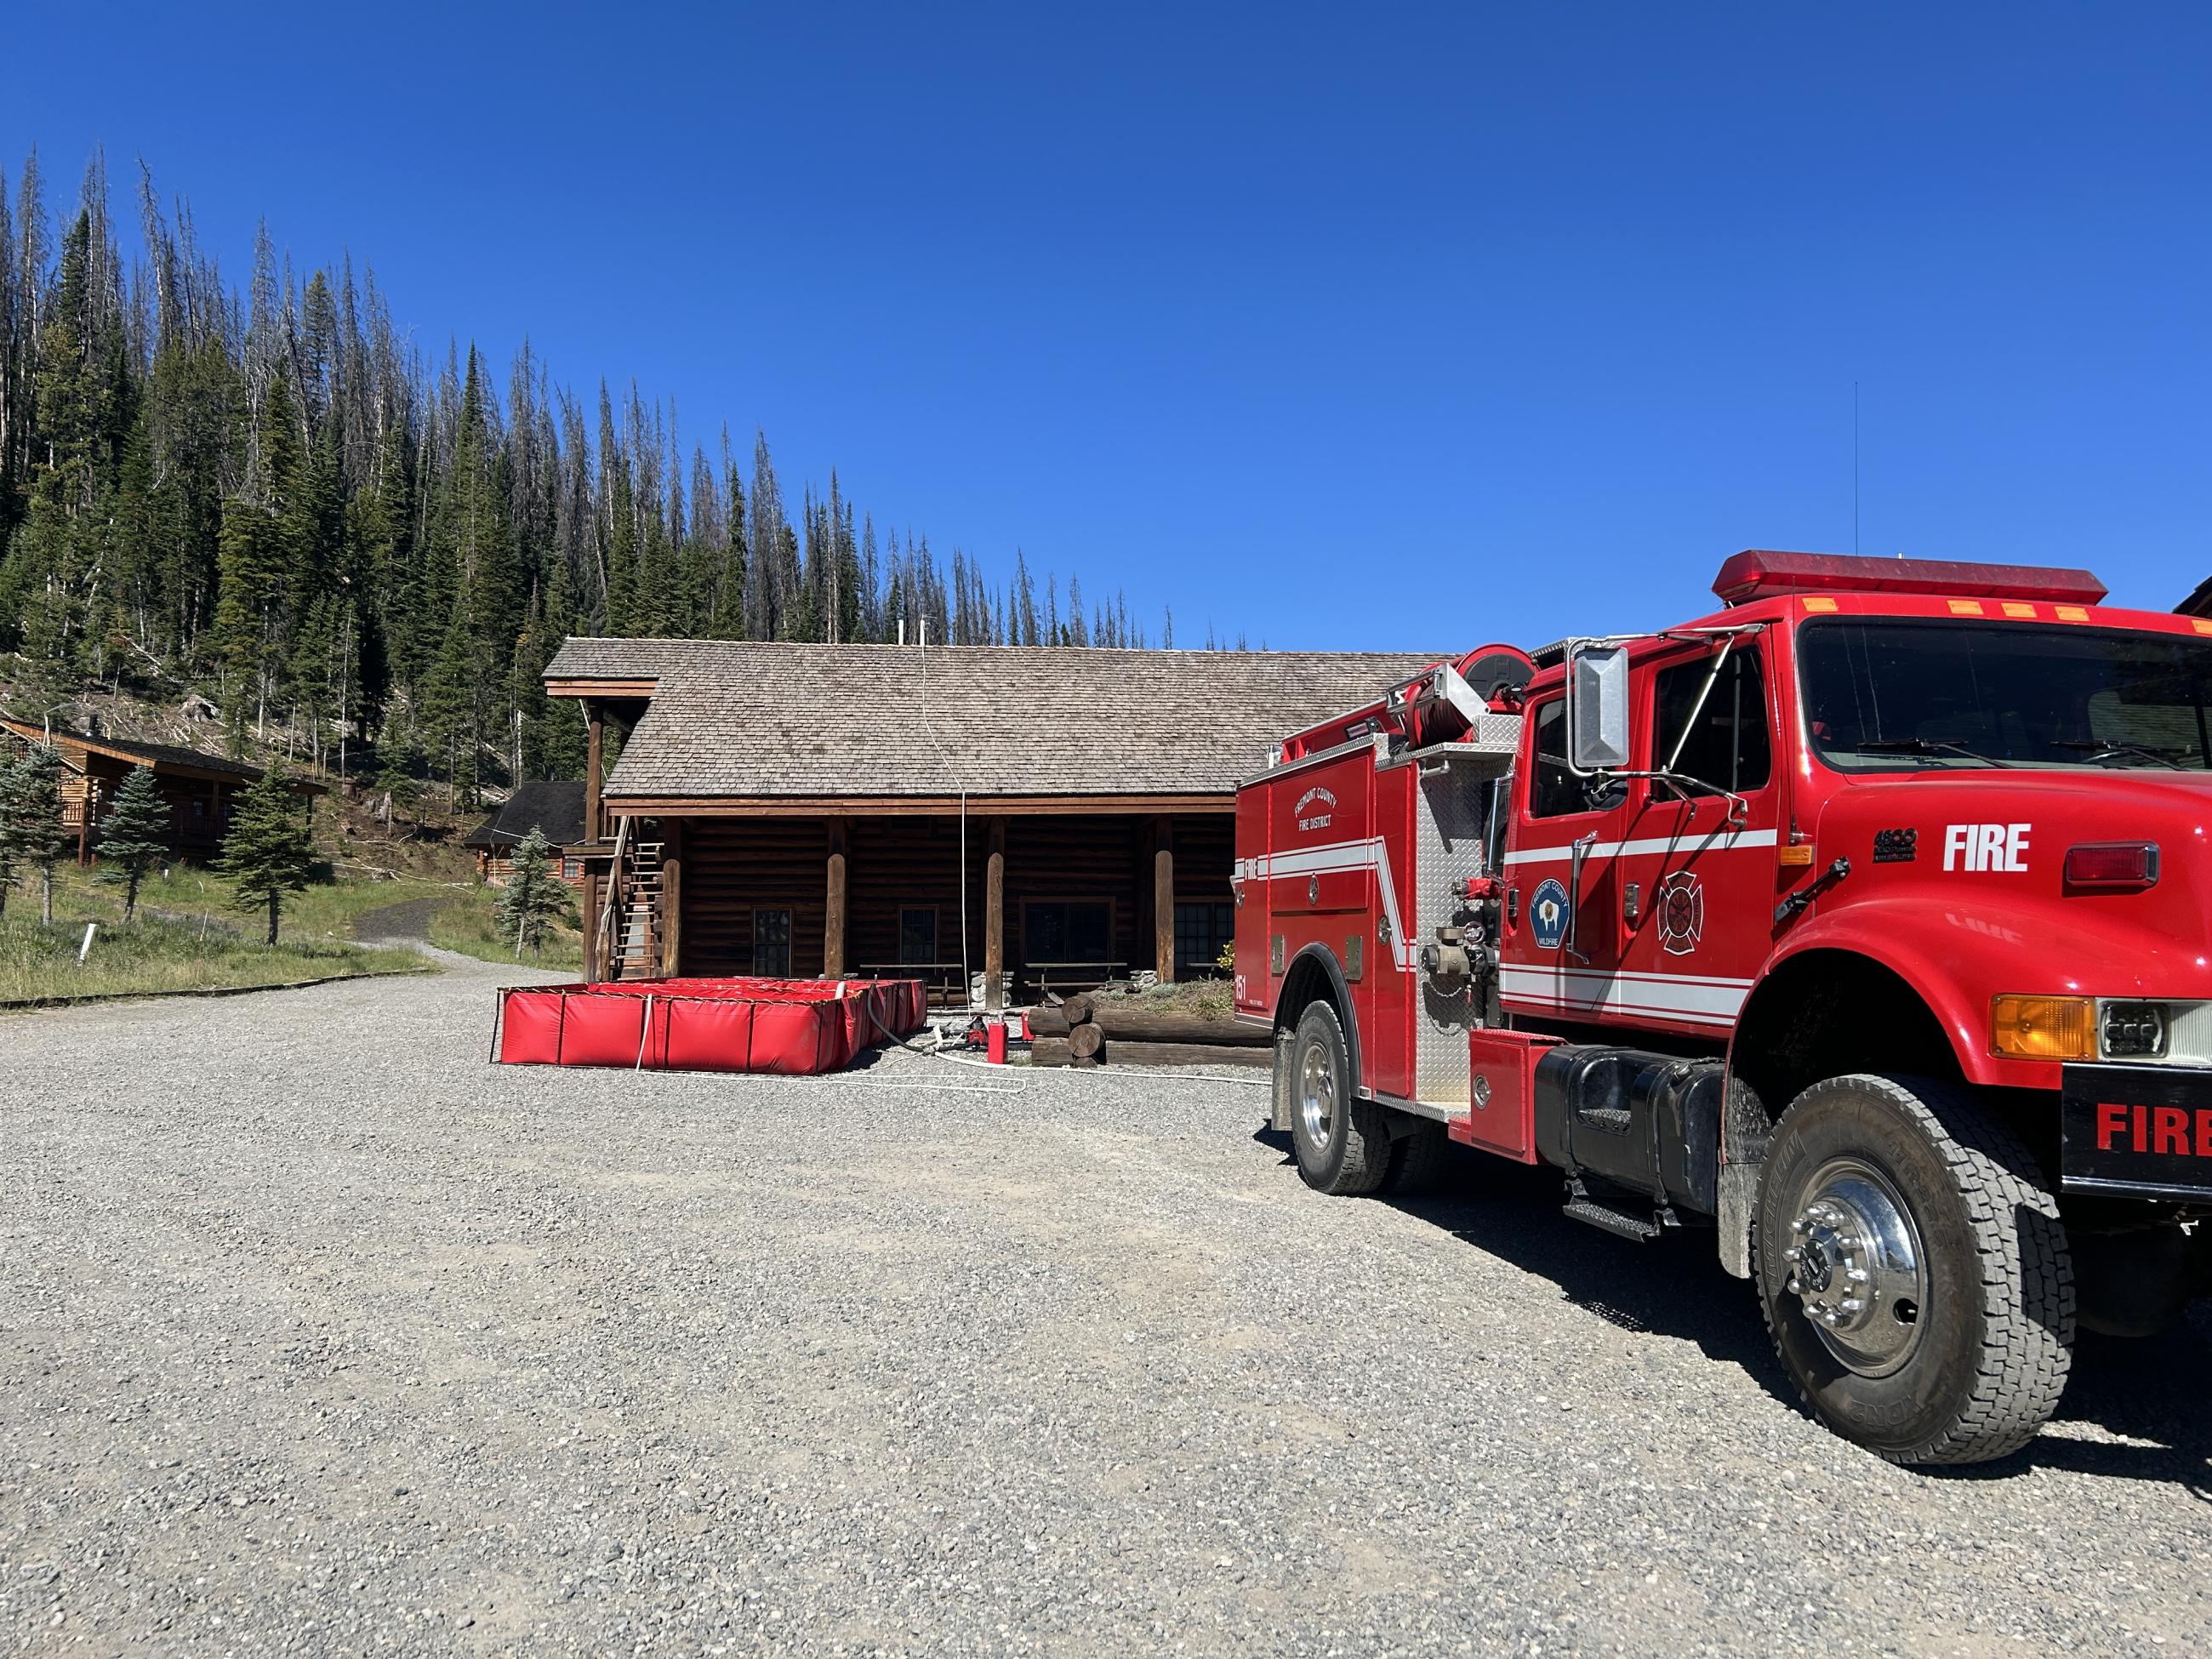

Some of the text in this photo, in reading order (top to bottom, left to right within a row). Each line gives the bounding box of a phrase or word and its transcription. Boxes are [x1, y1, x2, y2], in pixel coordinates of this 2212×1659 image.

[1295, 787, 1337, 818] FREMONT COUNTY
[1299, 814, 1331, 831] FIRE DISTRICT
[1943, 824, 2032, 872] FIRE
[1245, 858, 1257, 880] FIRE
[1532, 881, 1568, 909] FREMONT COUNTY
[1538, 938, 1558, 946] WILDFIRE
[1235, 974, 1246, 1001] 151
[2097, 1103, 2212, 1157] FIRE
